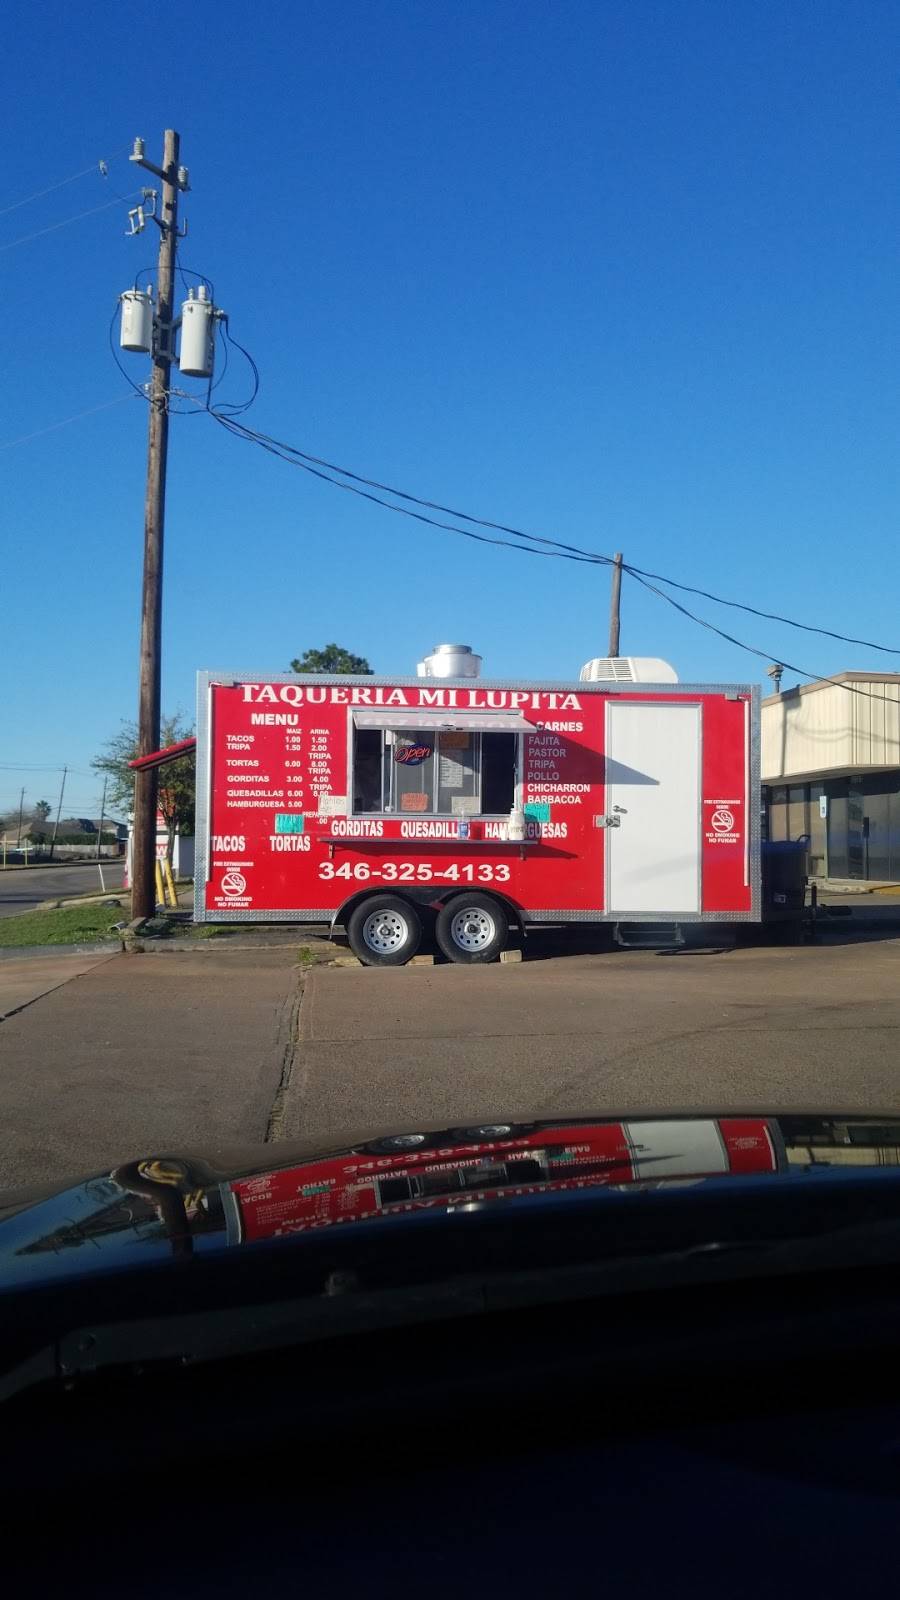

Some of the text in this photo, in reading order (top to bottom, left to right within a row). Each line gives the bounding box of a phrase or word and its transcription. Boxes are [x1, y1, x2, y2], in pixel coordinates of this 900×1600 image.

[241, 684, 583, 711] TAQUERIA MI LUPITA
[251, 713, 299, 725] MENU
[536, 721, 584, 732] CARNES
[226, 735, 255, 743] TACOS
[528, 737, 560, 746] FAJITA
[395, 747, 432, 763] Open
[528, 748, 567, 758] PASTOR
[528, 760, 556, 769] TRIPA
[227, 775, 270, 783] GORDITAS
[527, 772, 560, 781] POLLO
[527, 783, 591, 793] CHICHARRON
[226, 790, 284, 798] QUESADILLAS
[527, 795, 582, 805] BARBACOA
[331, 820, 384, 837] GORDITAS
[401, 821, 471, 839] QUESADILL
[484, 822, 568, 838] HAMGUESAS
[212, 836, 311, 852] TACOS TORTAS
[318, 862, 511, 881] 346-325-4133
